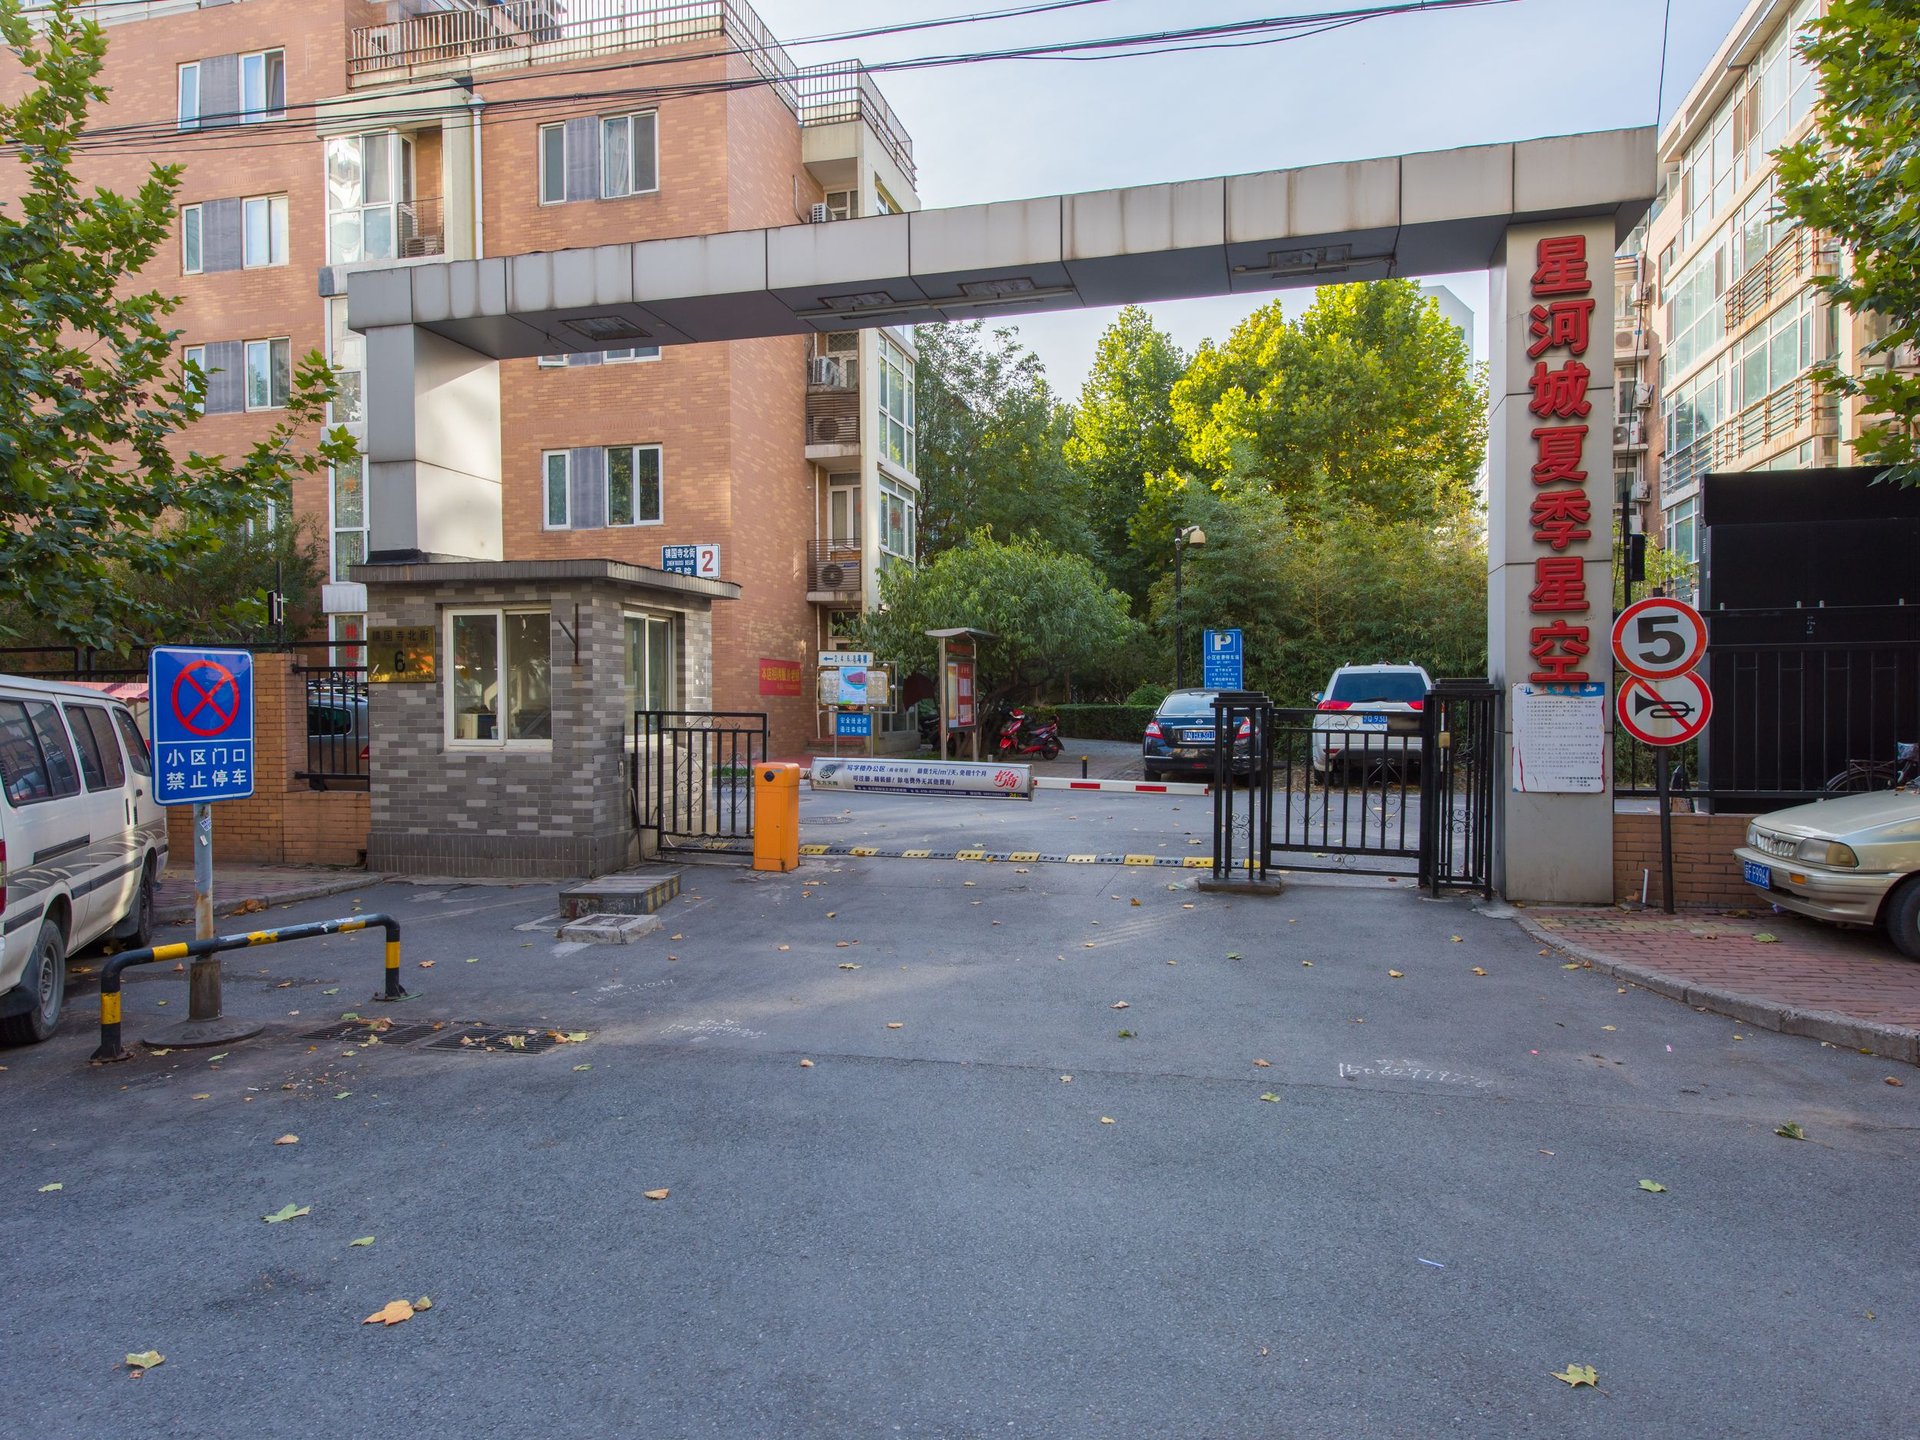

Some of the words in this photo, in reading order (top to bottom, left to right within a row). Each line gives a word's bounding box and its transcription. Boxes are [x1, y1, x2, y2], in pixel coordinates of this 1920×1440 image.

[1527, 235, 1595, 682] 星河城夏季星空
[701, 550, 714, 573] 2
[1214, 634, 1231, 651] P
[1637, 615, 1686, 664] 5
[394, 650, 406, 673] 6
[166, 748, 245, 767] 小区门口
[166, 769, 247, 790] 禁止停车
[992, 768, 1017, 789] 招商
